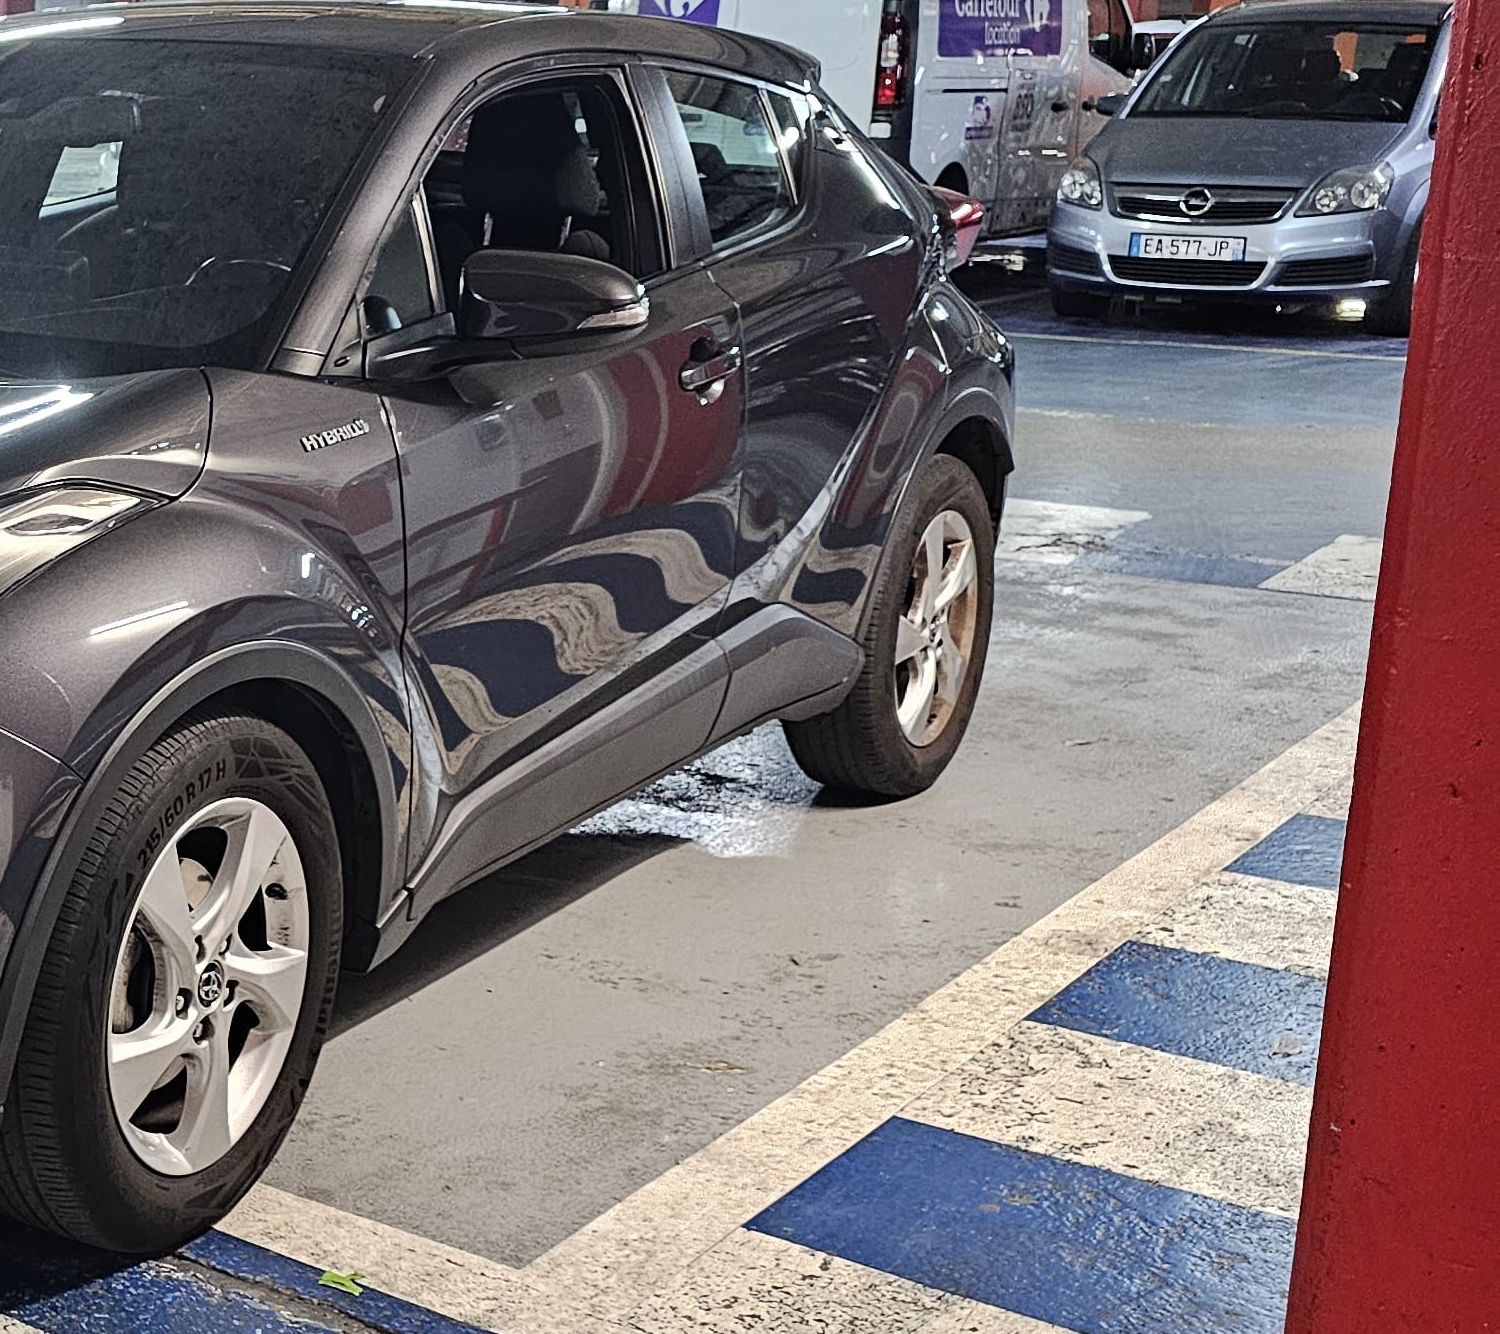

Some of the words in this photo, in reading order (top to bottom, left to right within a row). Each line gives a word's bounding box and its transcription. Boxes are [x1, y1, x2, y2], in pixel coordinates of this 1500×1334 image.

[984, 21, 1020, 45] location
[137, 794, 184, 867] 215/60
[185, 782, 197, 804] R
[199, 768, 212, 792] 17
